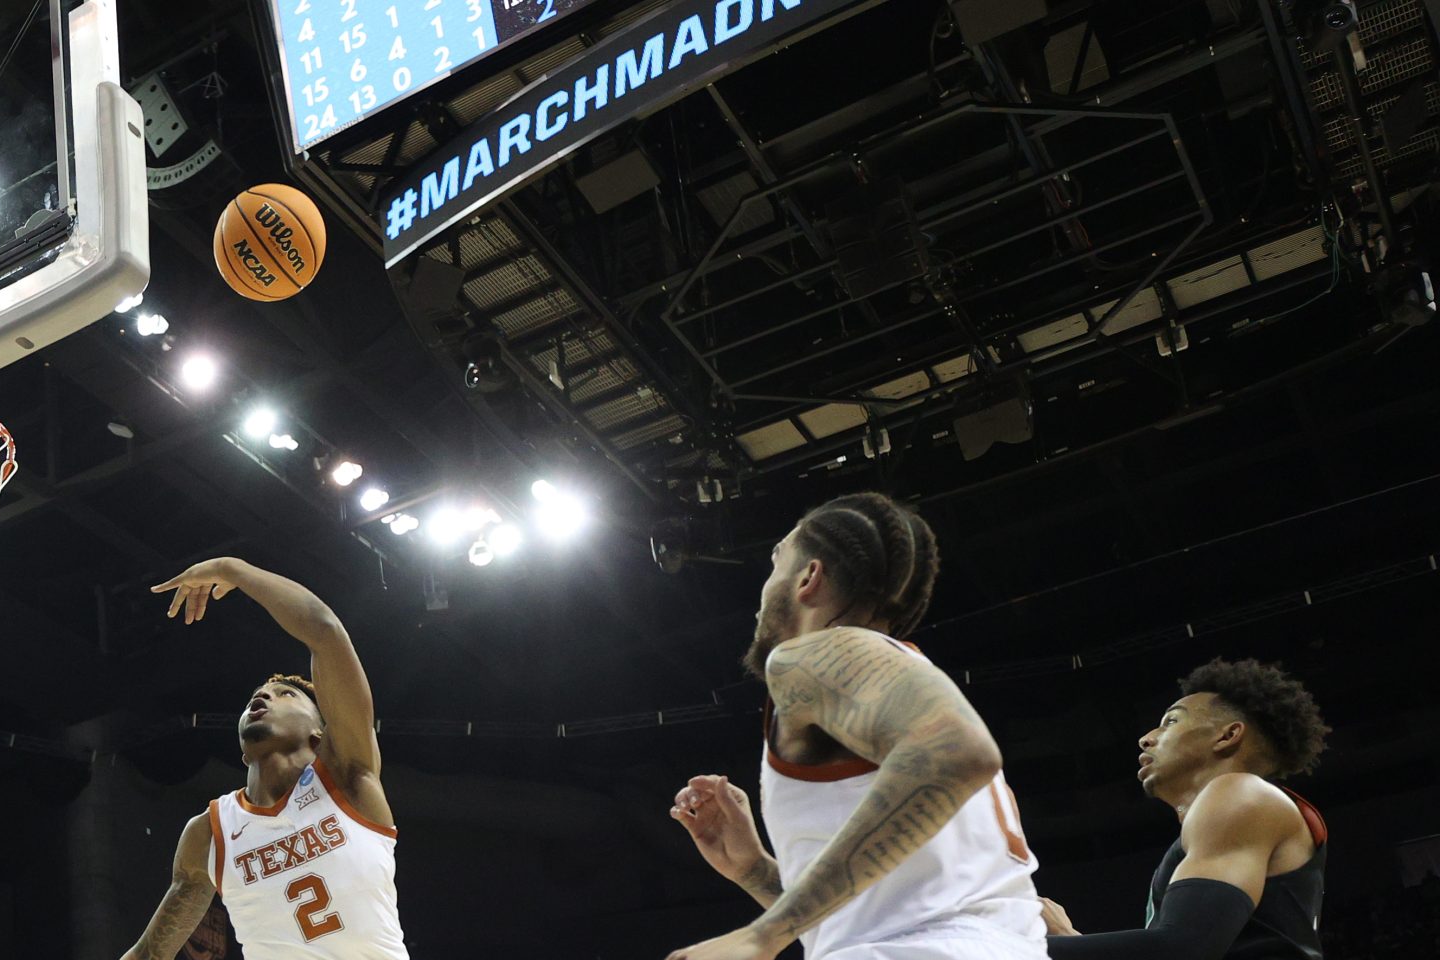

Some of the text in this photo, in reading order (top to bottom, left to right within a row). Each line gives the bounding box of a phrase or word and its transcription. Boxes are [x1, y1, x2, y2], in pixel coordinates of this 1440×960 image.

[297, 0, 358, 42] 4 2
[300, 46, 322, 74] 11
[338, 23, 367, 53] 15
[385, 5, 399, 28] 1
[302, 77, 329, 107] 15
[350, 58, 367, 82] 6
[388, 35, 407, 61] 4
[430, 15, 444, 38] 1
[303, 26, 486, 140] 24 13 0 2 1
[233, 238, 278, 287] NCAA
[255, 202, 305, 274] Wilson
[234, 813, 348, 886] TEXAS
[284, 872, 345, 943] 2
